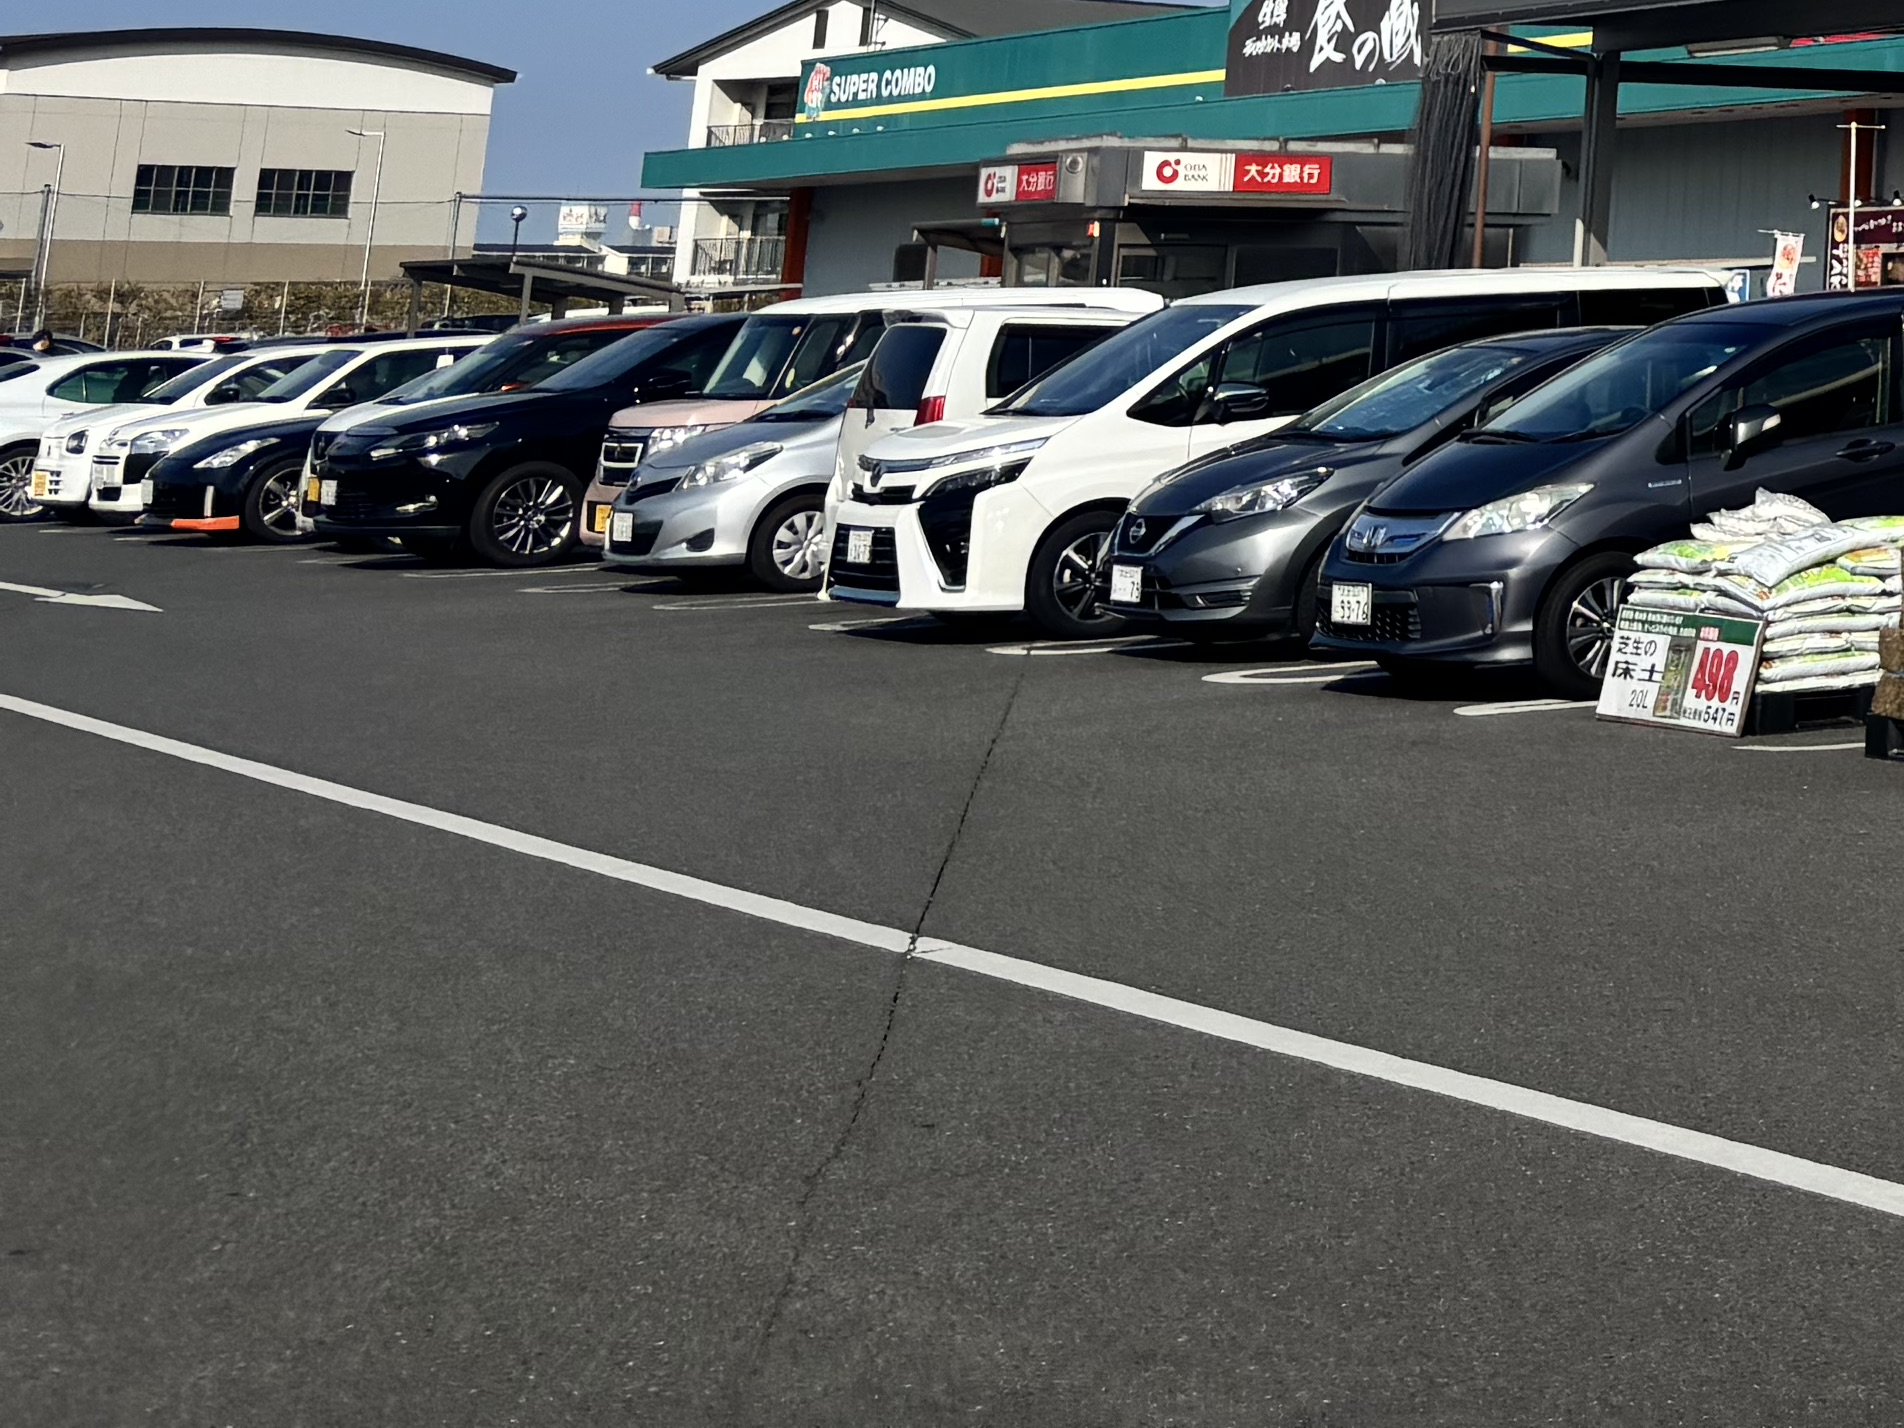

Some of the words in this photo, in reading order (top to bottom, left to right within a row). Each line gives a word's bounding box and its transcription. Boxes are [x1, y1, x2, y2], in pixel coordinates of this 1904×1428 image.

[830, 72, 878, 103] SUPER
[881, 64, 936, 97] COMBO
[1243, 163, 1321, 184] 大分銀行
[1617, 634, 1658, 658] 芝生の
[1611, 660, 1664, 684] 床土
[1691, 647, 1739, 704] 498
[1628, 689, 1649, 710] 20L
